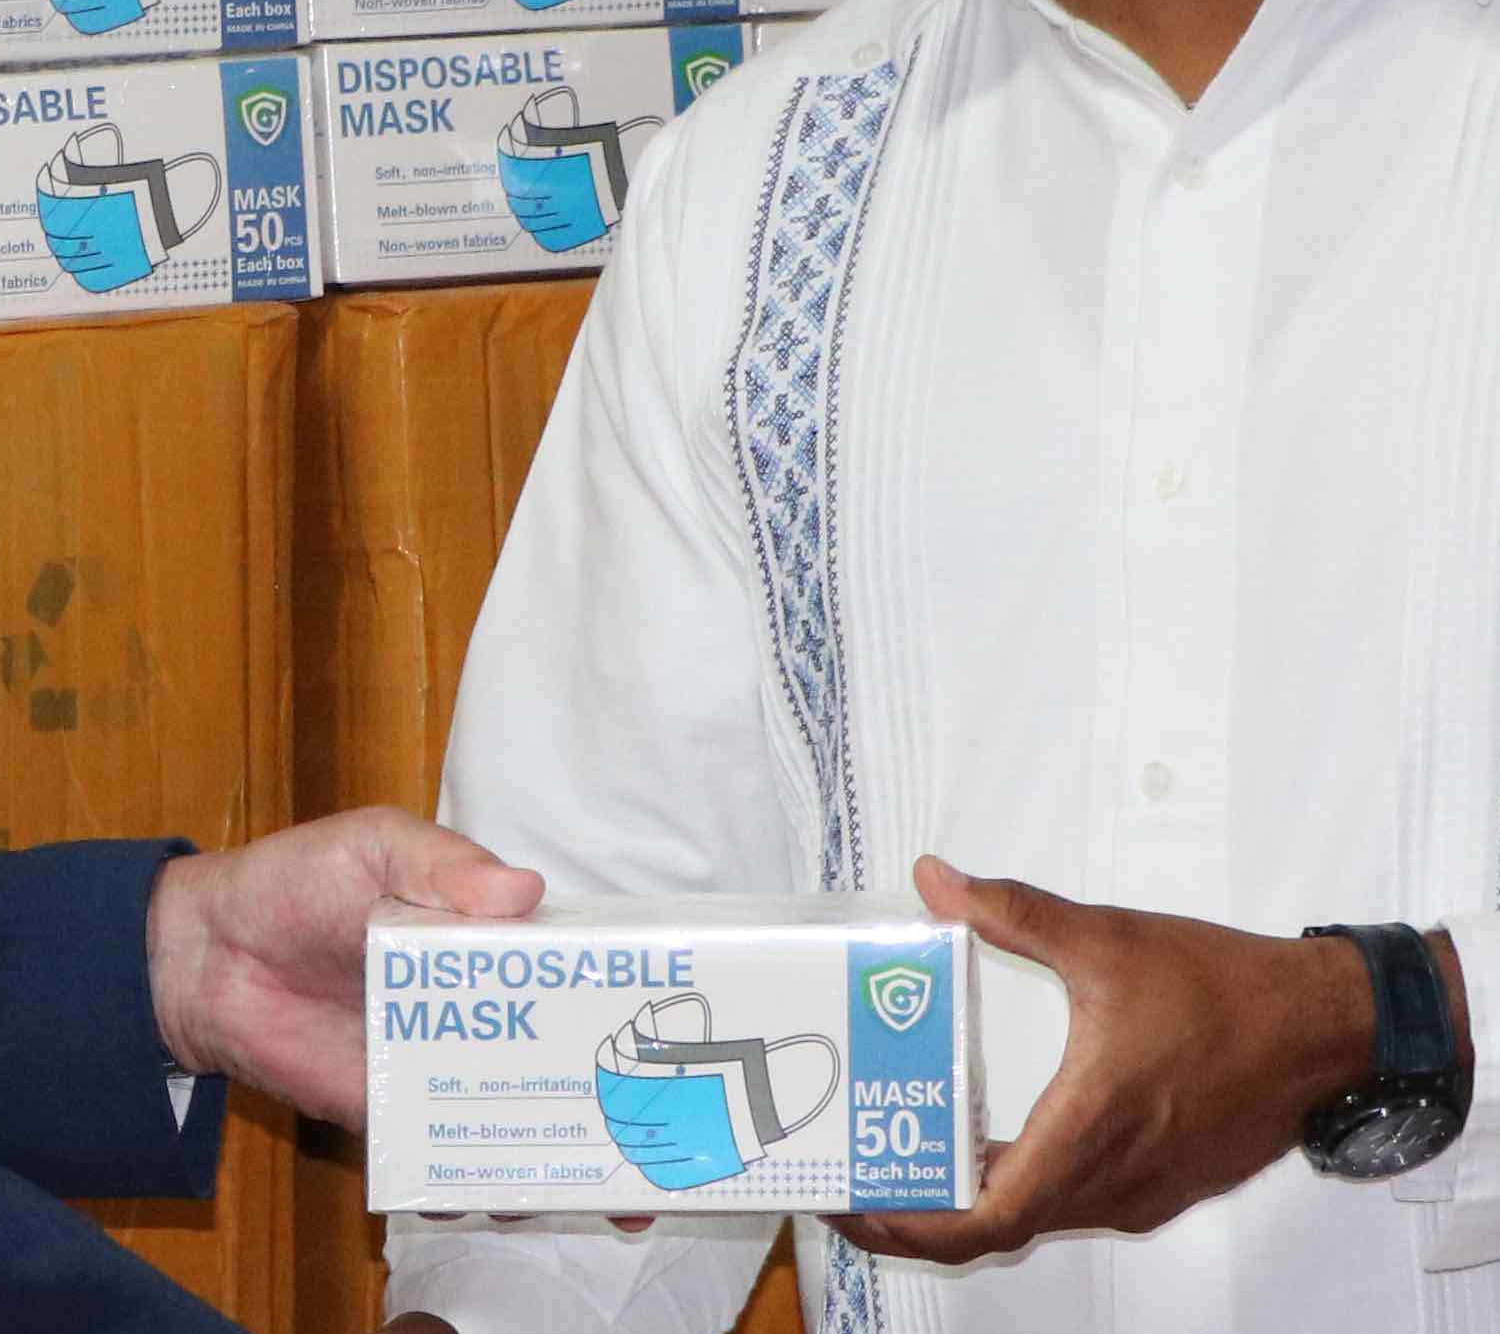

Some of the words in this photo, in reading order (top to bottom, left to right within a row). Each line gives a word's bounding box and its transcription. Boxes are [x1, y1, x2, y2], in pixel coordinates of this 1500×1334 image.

[226, 1, 261, 18] Each
[264, 0, 292, 16] box
[338, 49, 565, 94] DISPOSABLE
[341, 98, 454, 138] MASK
[233, 185, 302, 212] MASK
[235, 210, 284, 254] 50
[0, 240, 34, 255] cloth
[236, 256, 272, 273] Each
[275, 253, 304, 270] box
[2, 273, 48, 289] fabrics
[384, 949, 694, 989] DISPOSABLE
[385, 1000, 537, 1041] MASK
[855, 1080, 946, 1107] MASK
[428, 1124, 536, 1139] Melt-blown
[543, 1124, 587, 1139] cloth
[856, 1109, 920, 1157] 50
[920, 1141, 946, 1153] PCS
[428, 1165, 536, 1180] Non-woven
[544, 1164, 603, 1179] fabrics
[855, 1162, 903, 1180] Each
[908, 1162, 946, 1180] box
